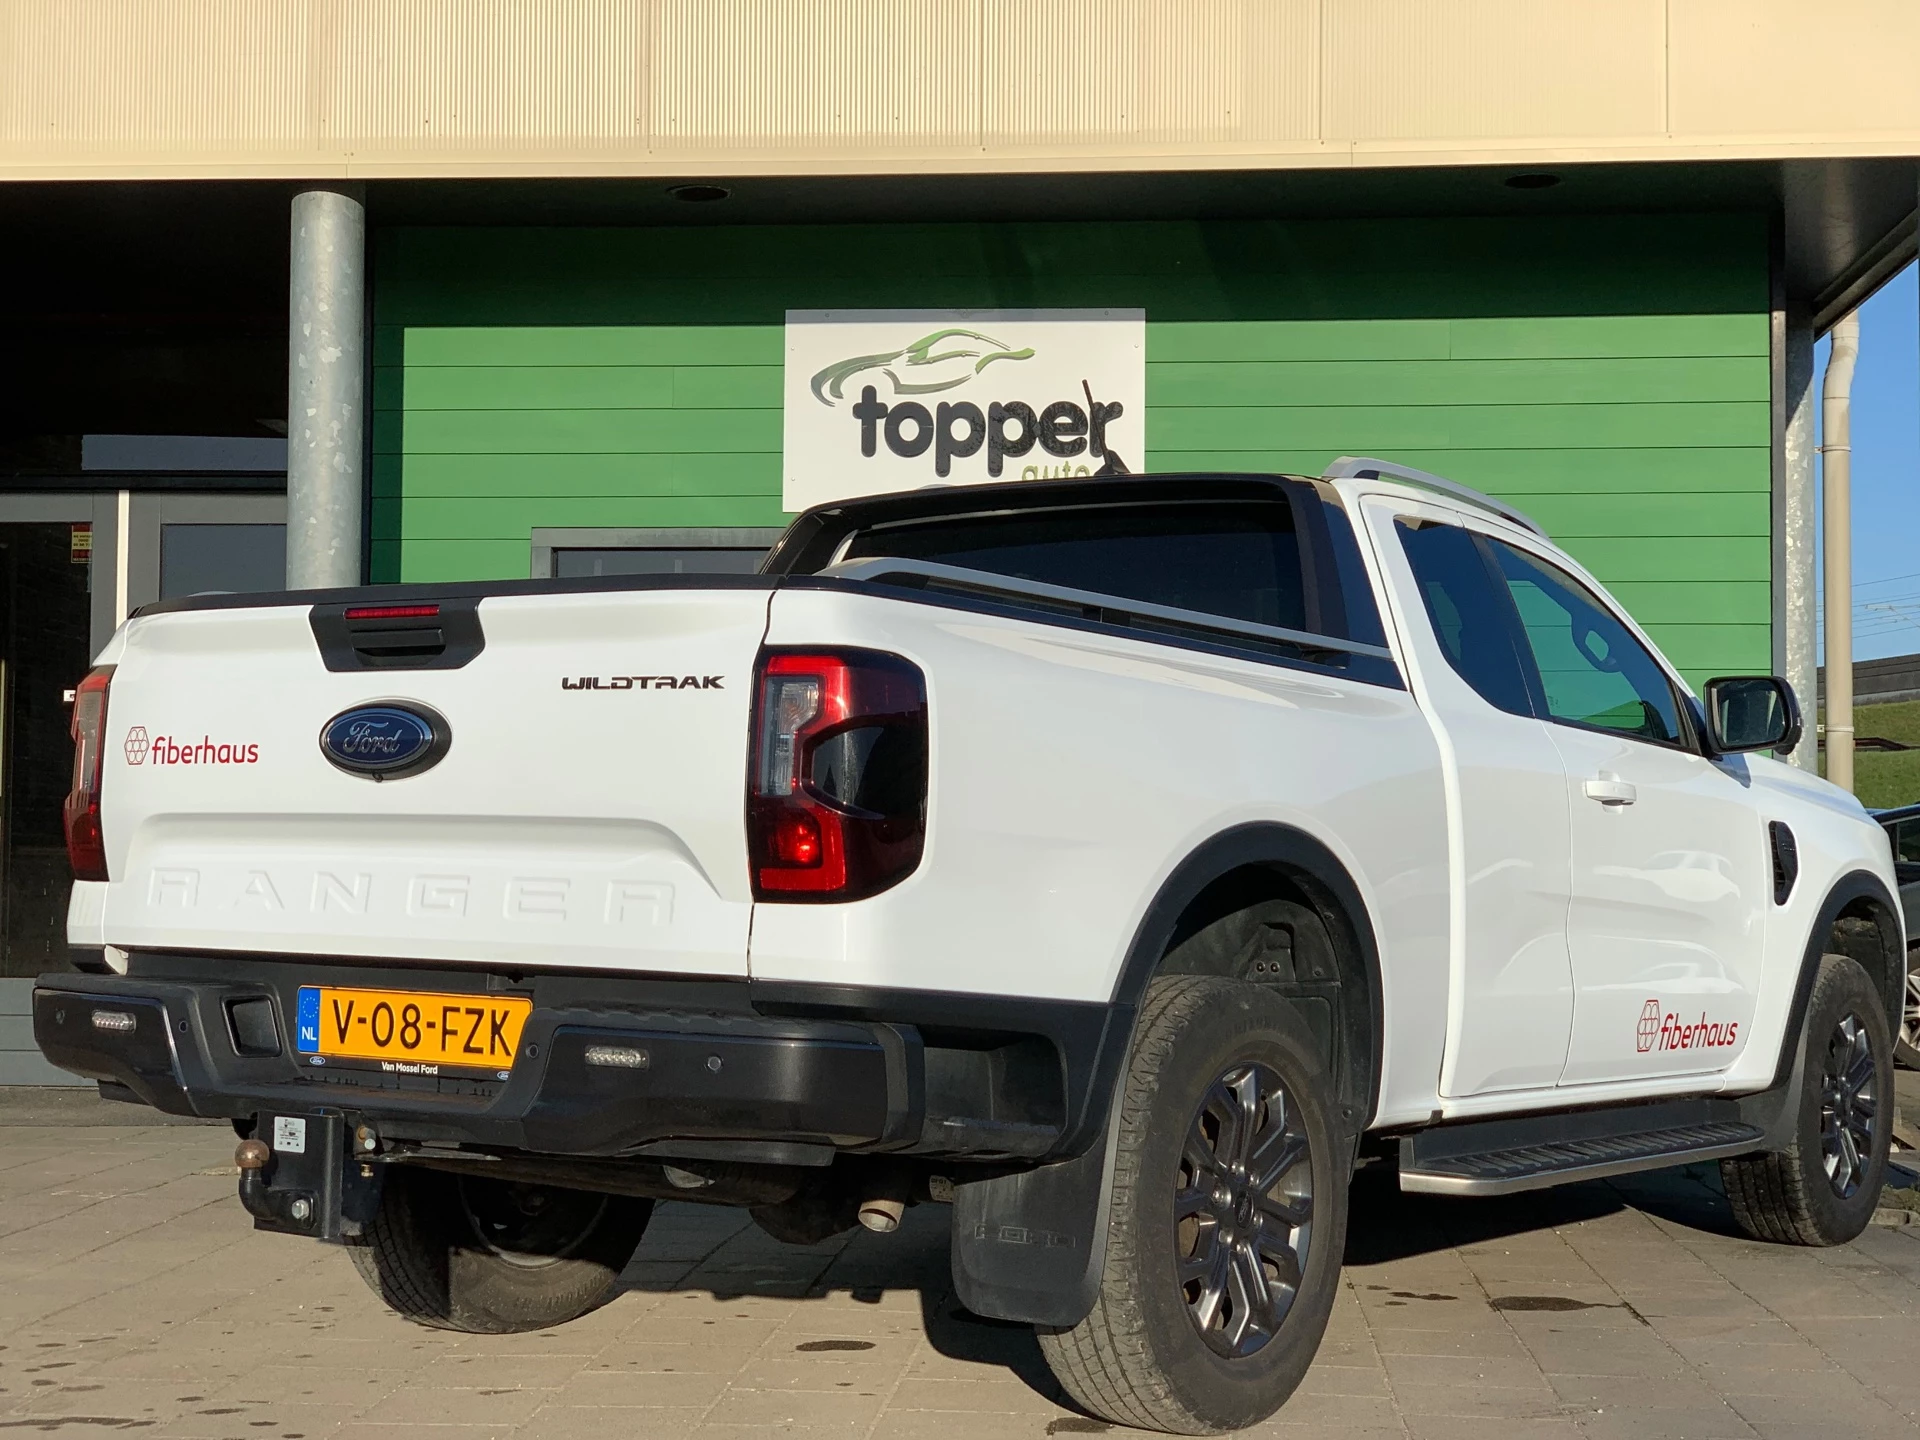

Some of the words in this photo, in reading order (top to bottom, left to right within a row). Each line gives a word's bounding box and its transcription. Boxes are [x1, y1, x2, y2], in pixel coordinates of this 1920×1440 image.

[852, 385, 1124, 477] topper
[1022, 460, 1091, 480] auto
[561, 675, 726, 690] WILDTRAK
[151, 735, 259, 765] fiberhaus
[343, 720, 403, 754] Ford
[146, 866, 677, 926] RANGER
[301, 1026, 318, 1041] NL
[332, 998, 513, 1057] V-08-FZK
[1658, 1011, 1739, 1052] fiberhaus
[381, 1061, 395, 1071] Van
[395, 1062, 420, 1074] Mossel
[420, 1064, 439, 1075] Ford
